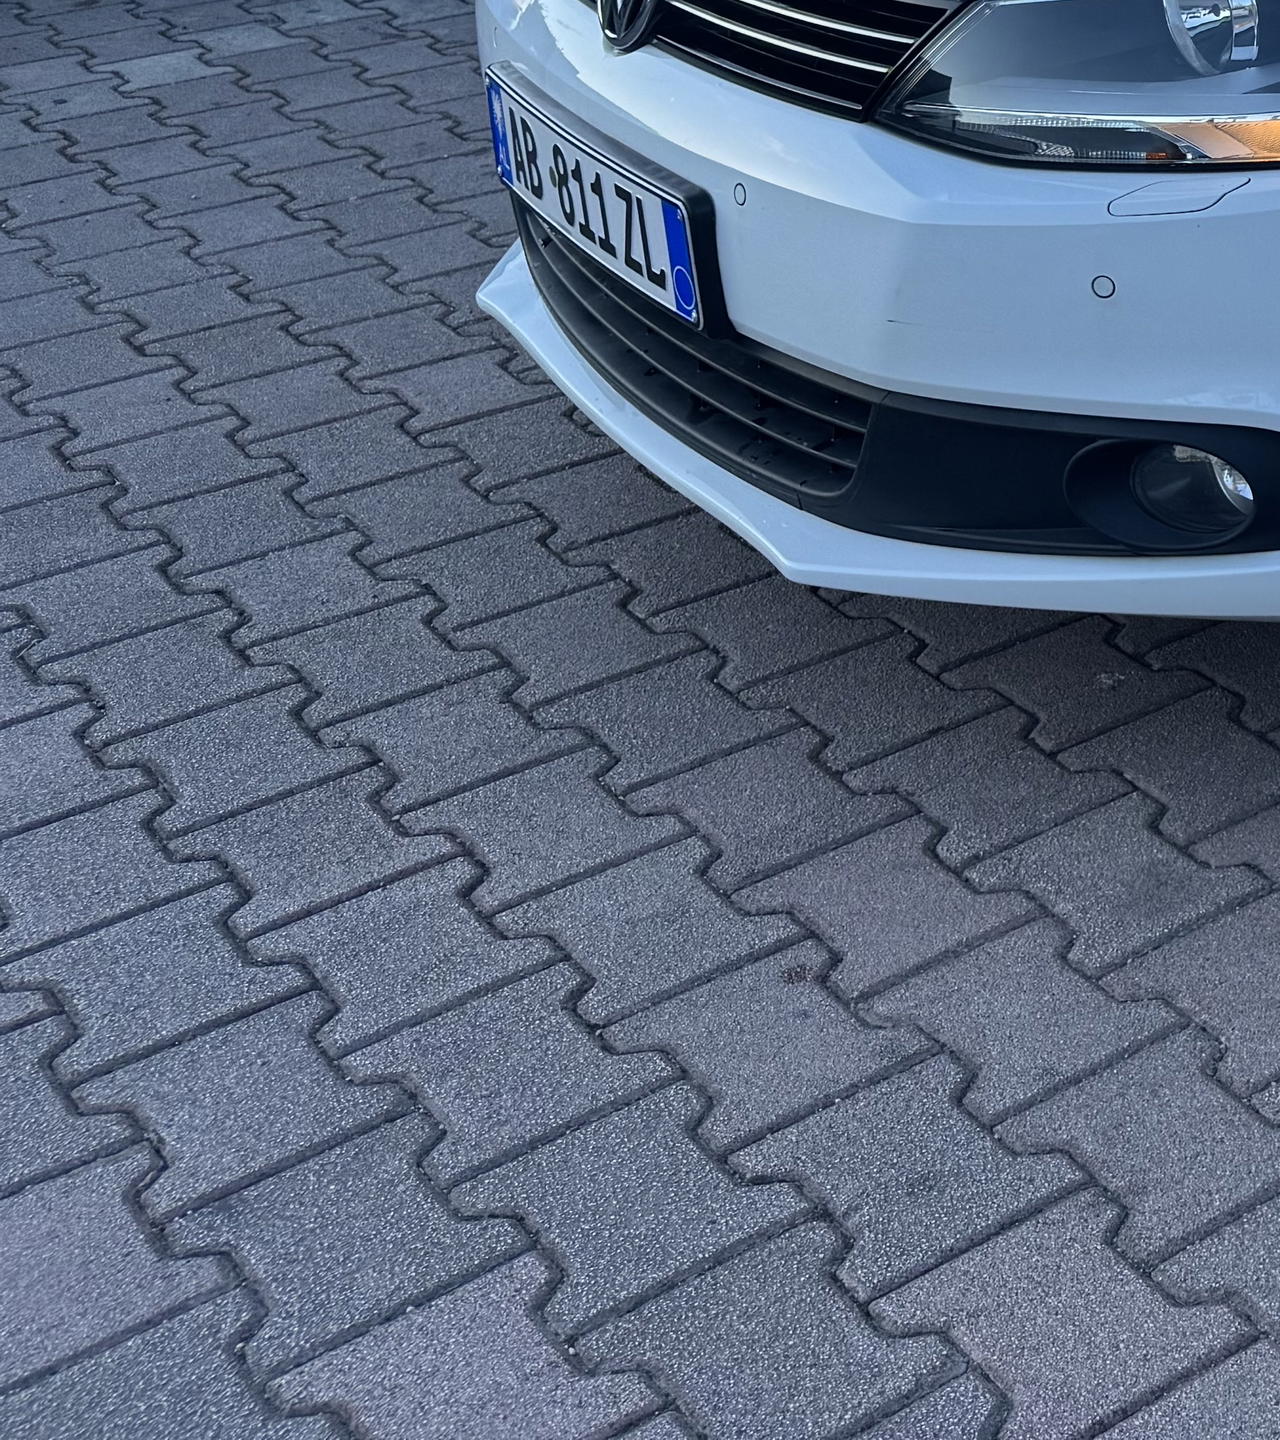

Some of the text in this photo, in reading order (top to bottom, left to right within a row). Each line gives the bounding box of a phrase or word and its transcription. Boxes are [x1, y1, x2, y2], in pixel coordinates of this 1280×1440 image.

[508, 107, 667, 290] AB 811 ZL
